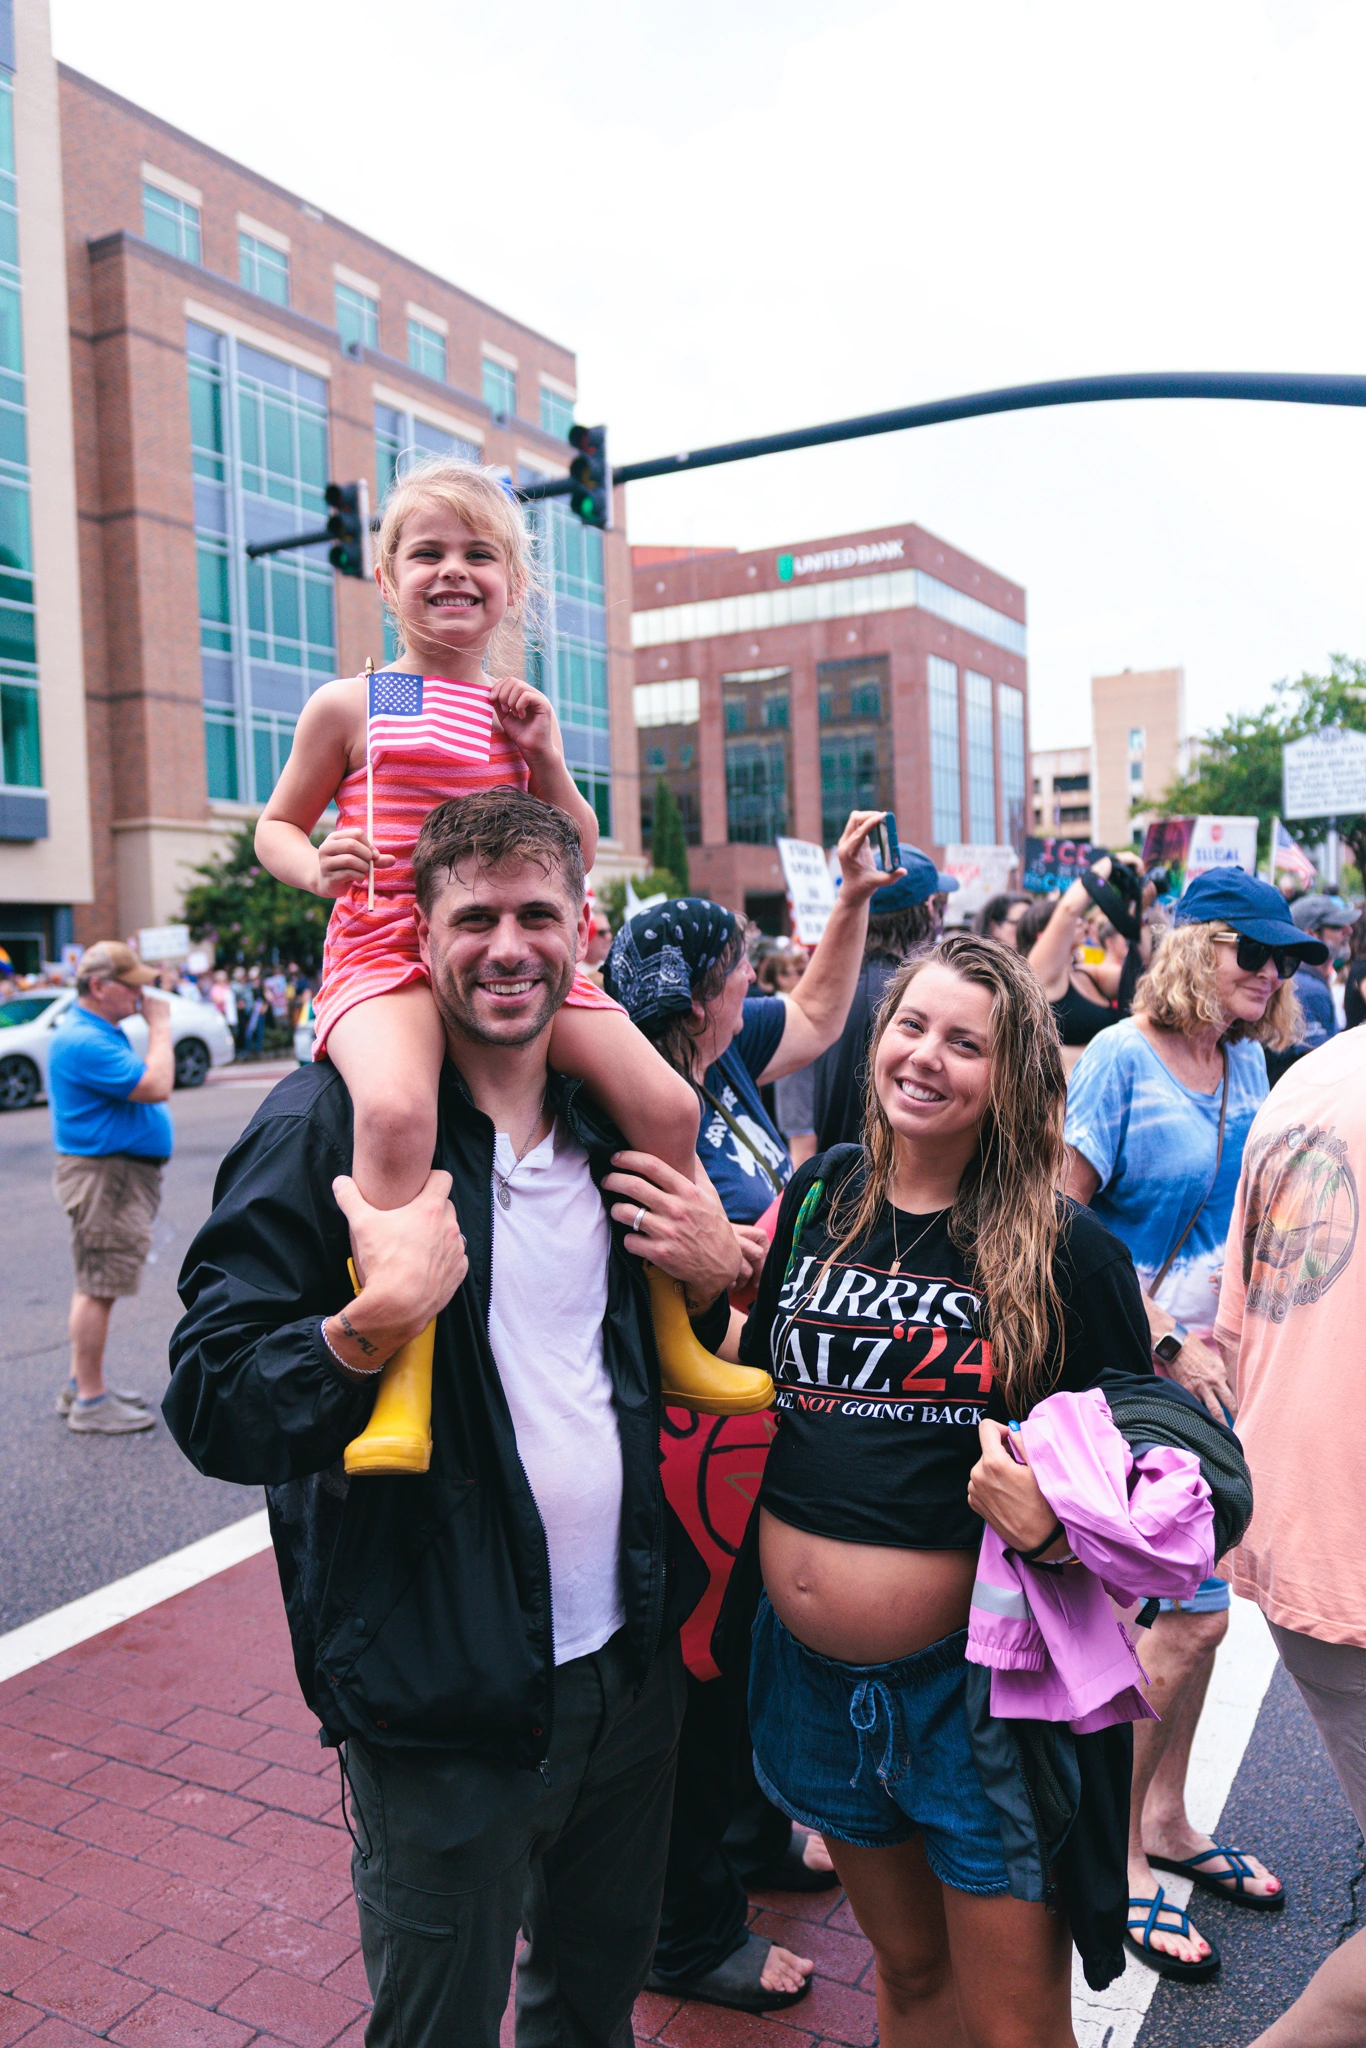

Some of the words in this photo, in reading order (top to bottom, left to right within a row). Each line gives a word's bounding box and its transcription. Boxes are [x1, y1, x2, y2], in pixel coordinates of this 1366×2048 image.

[794, 547, 857, 576] UNITED
[857, 538, 904, 565] BANK
[1039, 837, 1093, 867] ICE
[704, 1110, 728, 1148] SAV
[1306, 1124, 1348, 1164] Relax
[797, 1394, 841, 1413] NOT
[841, 1400, 914, 1422] GOING
[921, 1406, 987, 1425] BACK
